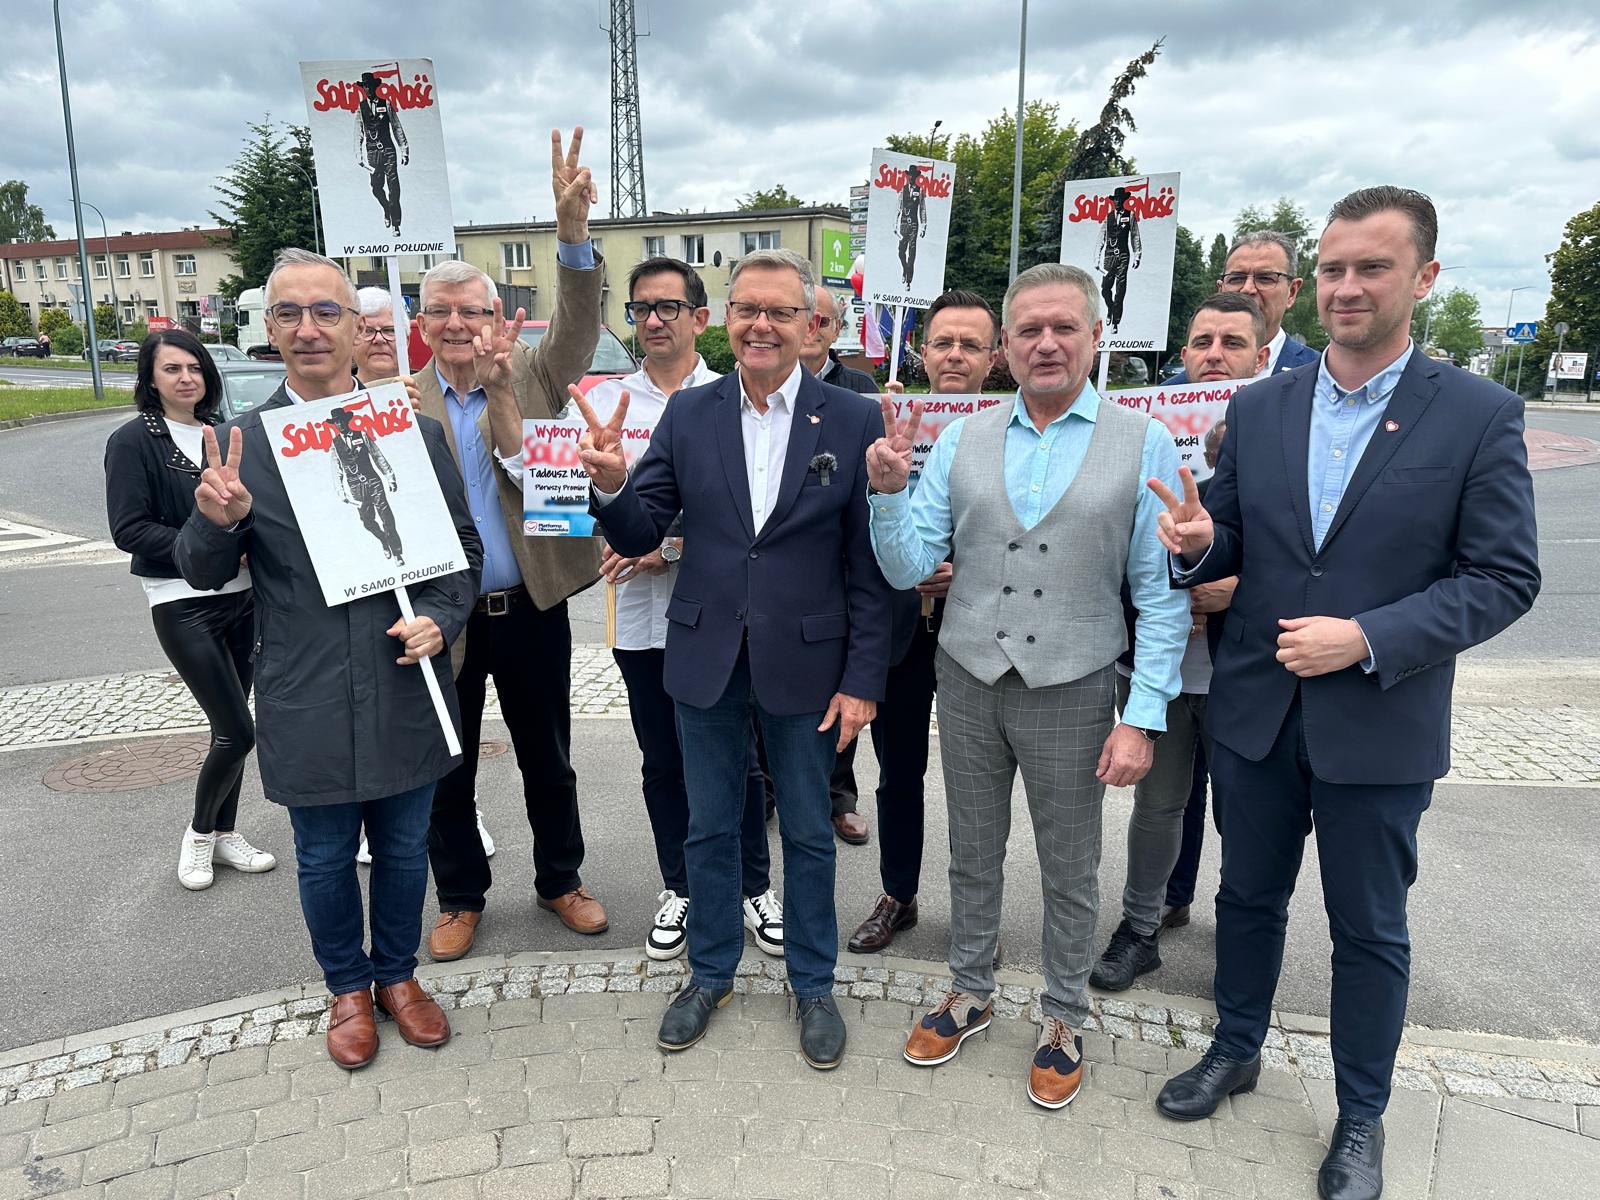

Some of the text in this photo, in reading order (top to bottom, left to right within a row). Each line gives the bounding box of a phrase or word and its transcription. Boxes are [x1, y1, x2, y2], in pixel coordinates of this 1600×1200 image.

[343, 242, 444, 254] W SAMO POŁUDNIE
[829, 261, 845, 273] 2 km
[882, 294, 902, 304] SAMO
[1108, 340, 1154, 349] POŁUDNIE
[1157, 391, 1166, 406] 4
[1170, 389, 1232, 405] czerwca
[923, 401, 974, 413] zerwca
[534, 424, 581, 443] Wybory
[529, 468, 568, 479] Tadeusz
[344, 561, 455, 597] W SAMO POŁUDNIE
